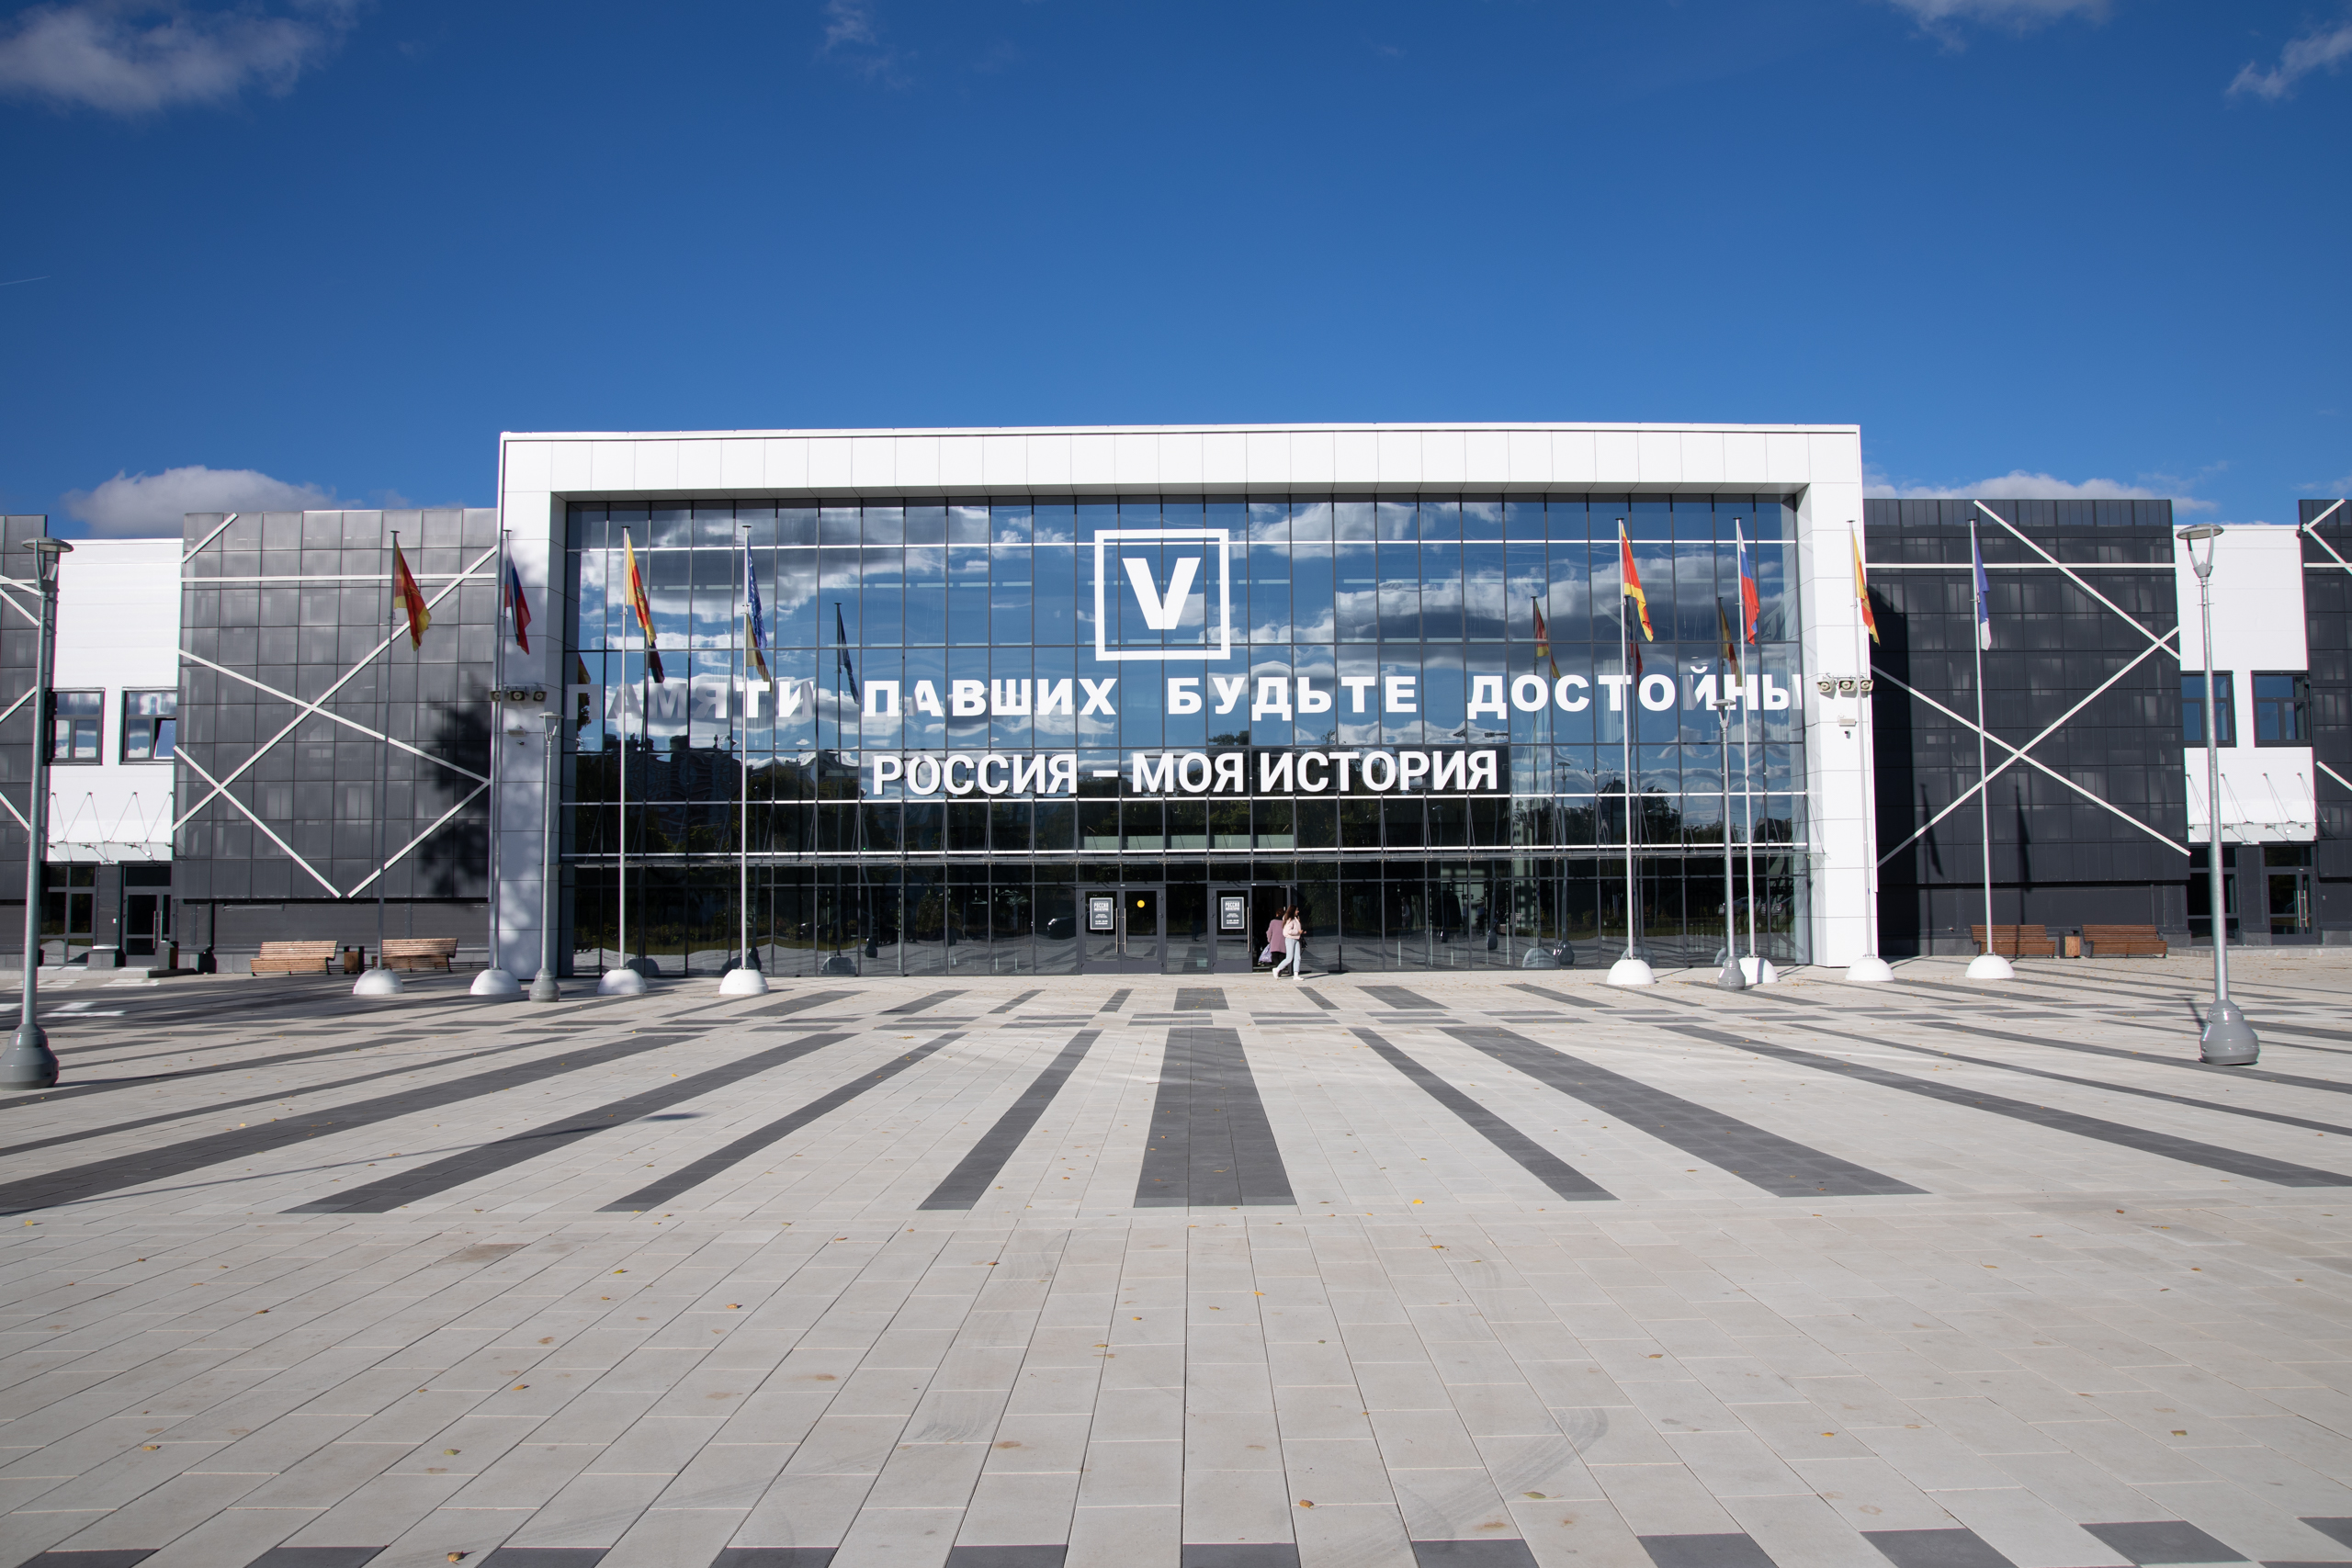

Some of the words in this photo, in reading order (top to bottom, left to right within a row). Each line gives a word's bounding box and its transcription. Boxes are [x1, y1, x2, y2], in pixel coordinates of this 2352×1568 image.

[567, 681, 813, 719] ПАМЯТИ
[864, 678, 1117, 717] ПАВШИХ
[1168, 676, 1417, 722] БУДЬТЕ
[1467, 666, 1803, 720] ДОСТОЙНЫ
[874, 753, 1078, 795] РОССИЯ
[1132, 751, 1244, 794] МОЯ
[1260, 750, 1498, 793] ИСТОРИЯ
